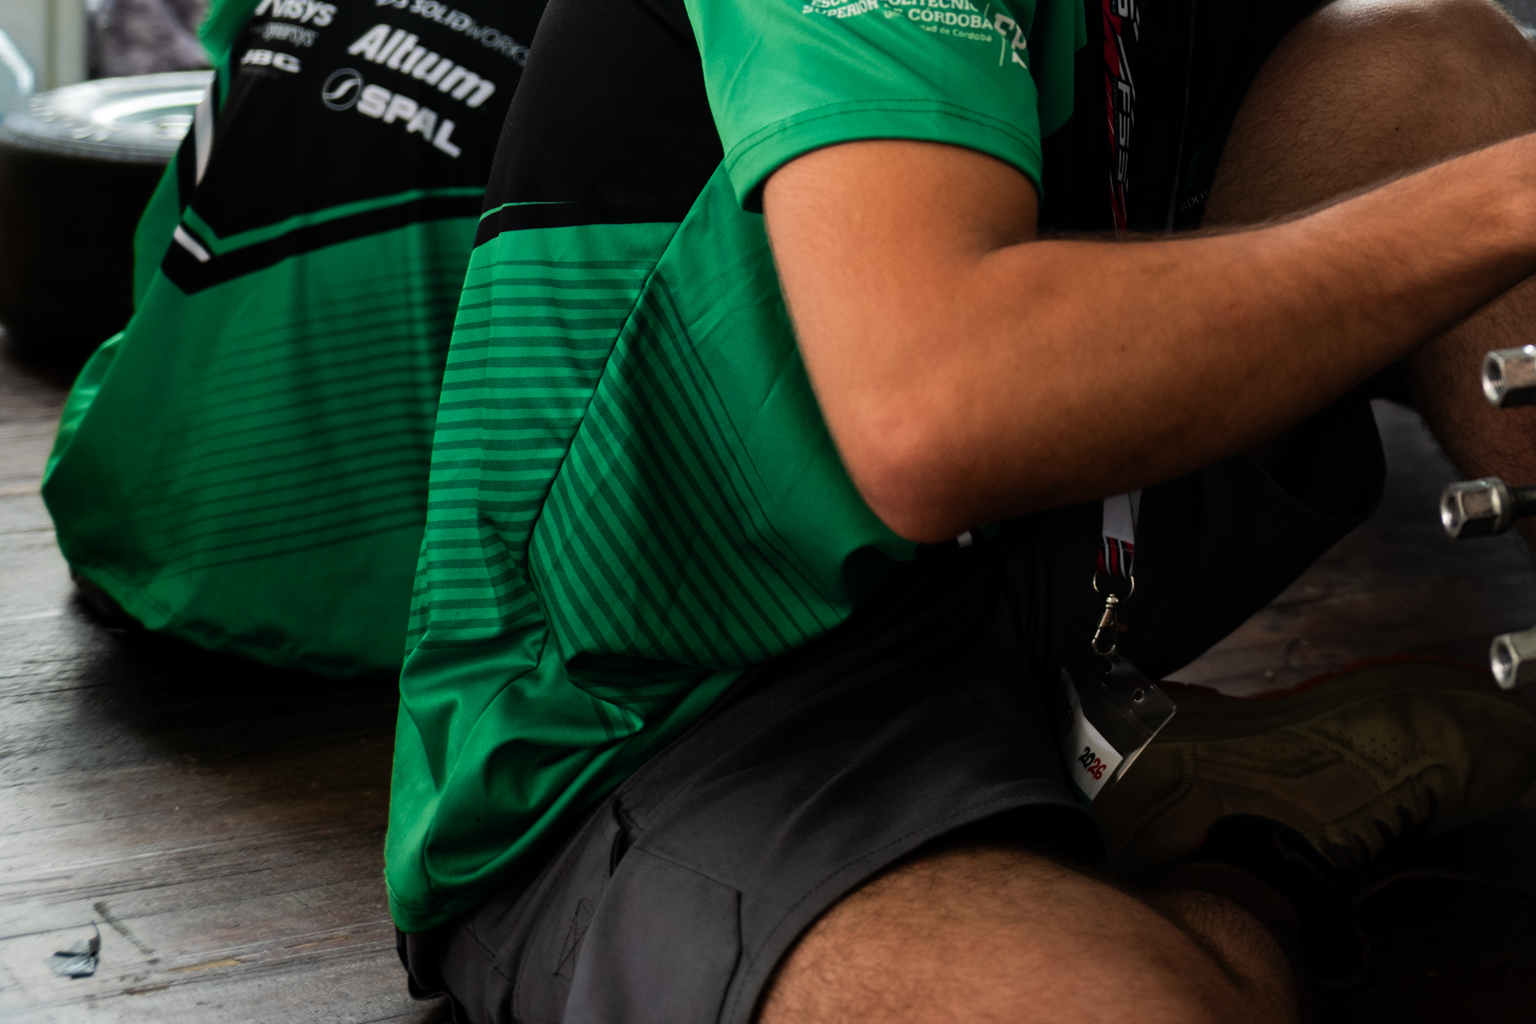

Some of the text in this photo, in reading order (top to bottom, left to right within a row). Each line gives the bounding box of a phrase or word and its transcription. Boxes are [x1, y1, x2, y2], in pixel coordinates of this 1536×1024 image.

[908, 7, 994, 30] CÓRDOBA
[348, 23, 496, 109] Altium
[356, 84, 462, 158] SPAL
[1117, 81, 1131, 184] FSS
